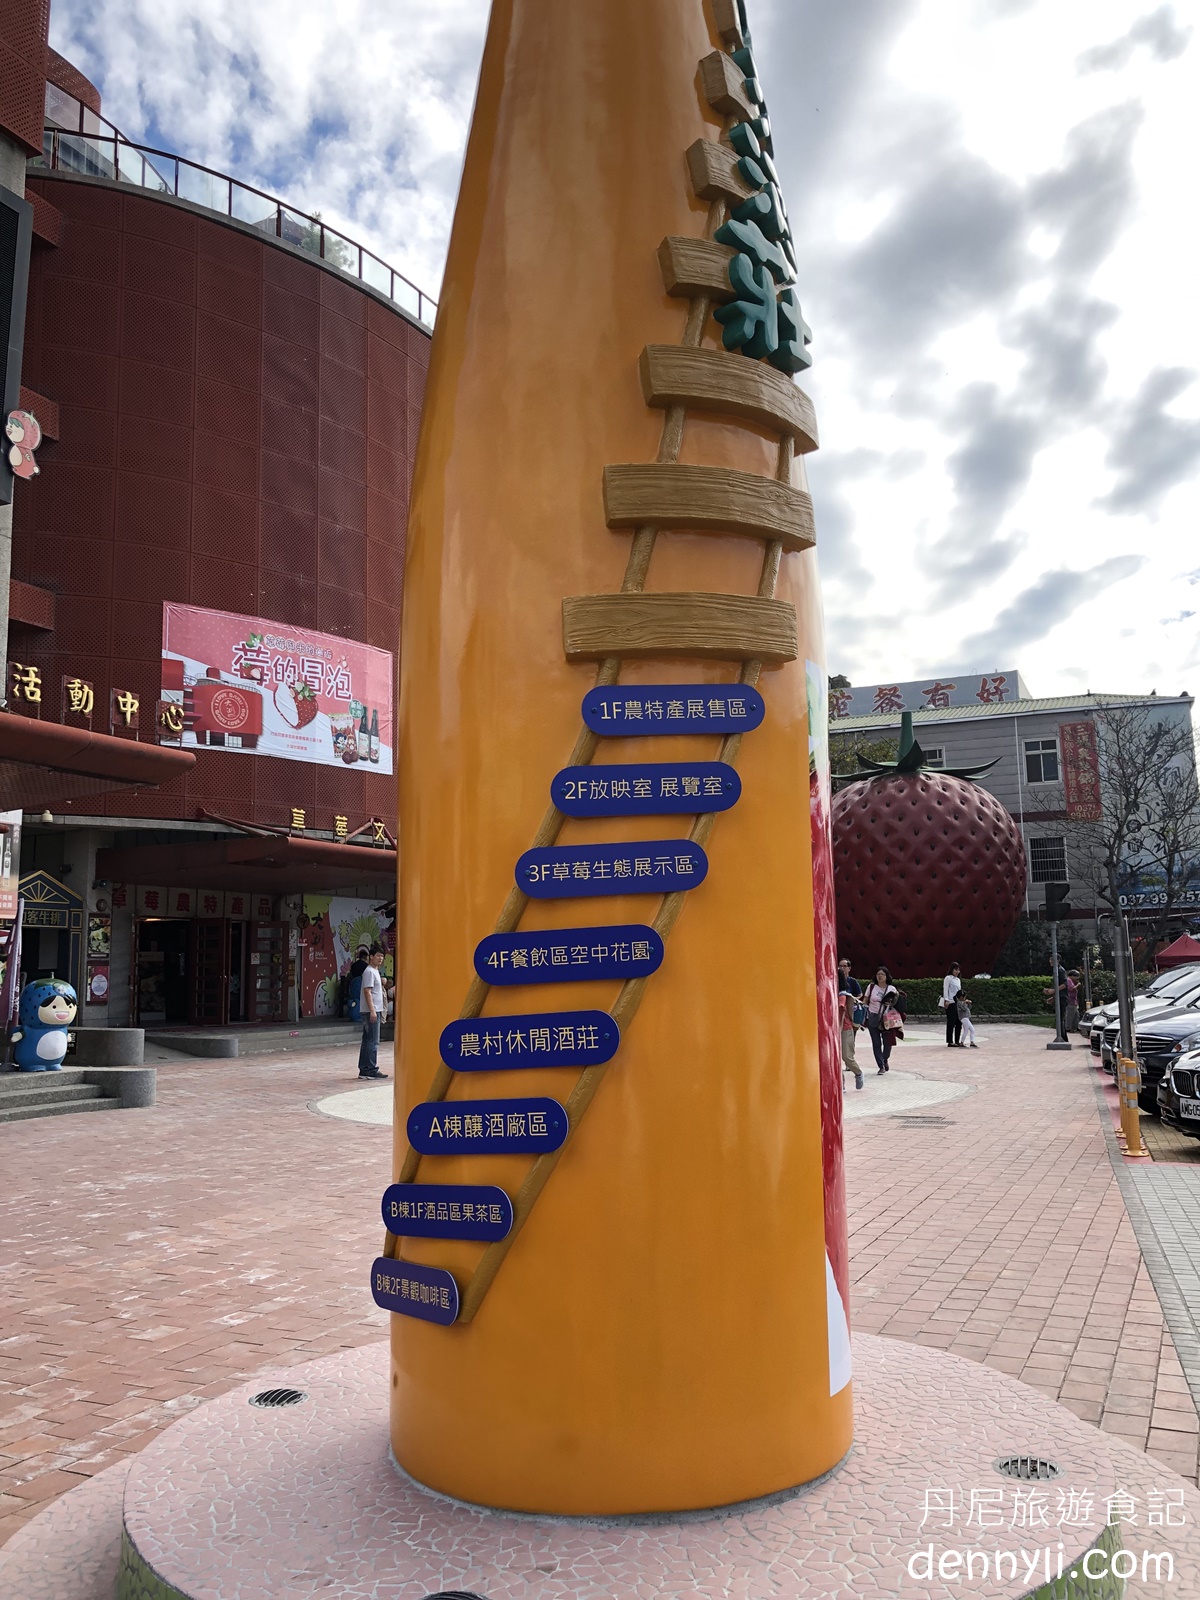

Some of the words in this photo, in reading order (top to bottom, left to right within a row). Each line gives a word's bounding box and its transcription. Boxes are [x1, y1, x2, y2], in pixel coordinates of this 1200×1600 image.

[13, 662, 185, 732] 活動中心
[599, 697, 748, 722] 1F農特產展售區
[564, 778, 654, 802] 2F放映室
[660, 775, 724, 798] 展覽室
[529, 855, 694, 883] 3F草莓生態展示區
[112, 888, 271, 917] 草莓農特產品
[487, 940, 651, 970] 4F餐飲區空中花園
[459, 1025, 600, 1058] 農村休閒酒莊
[428, 1110, 549, 1140] A棟釀酒廠區
[390, 1200, 504, 1225] B棟1F酒品區果茶區
[376, 1272, 452, 1311] B棟2F景觀咖啡區
